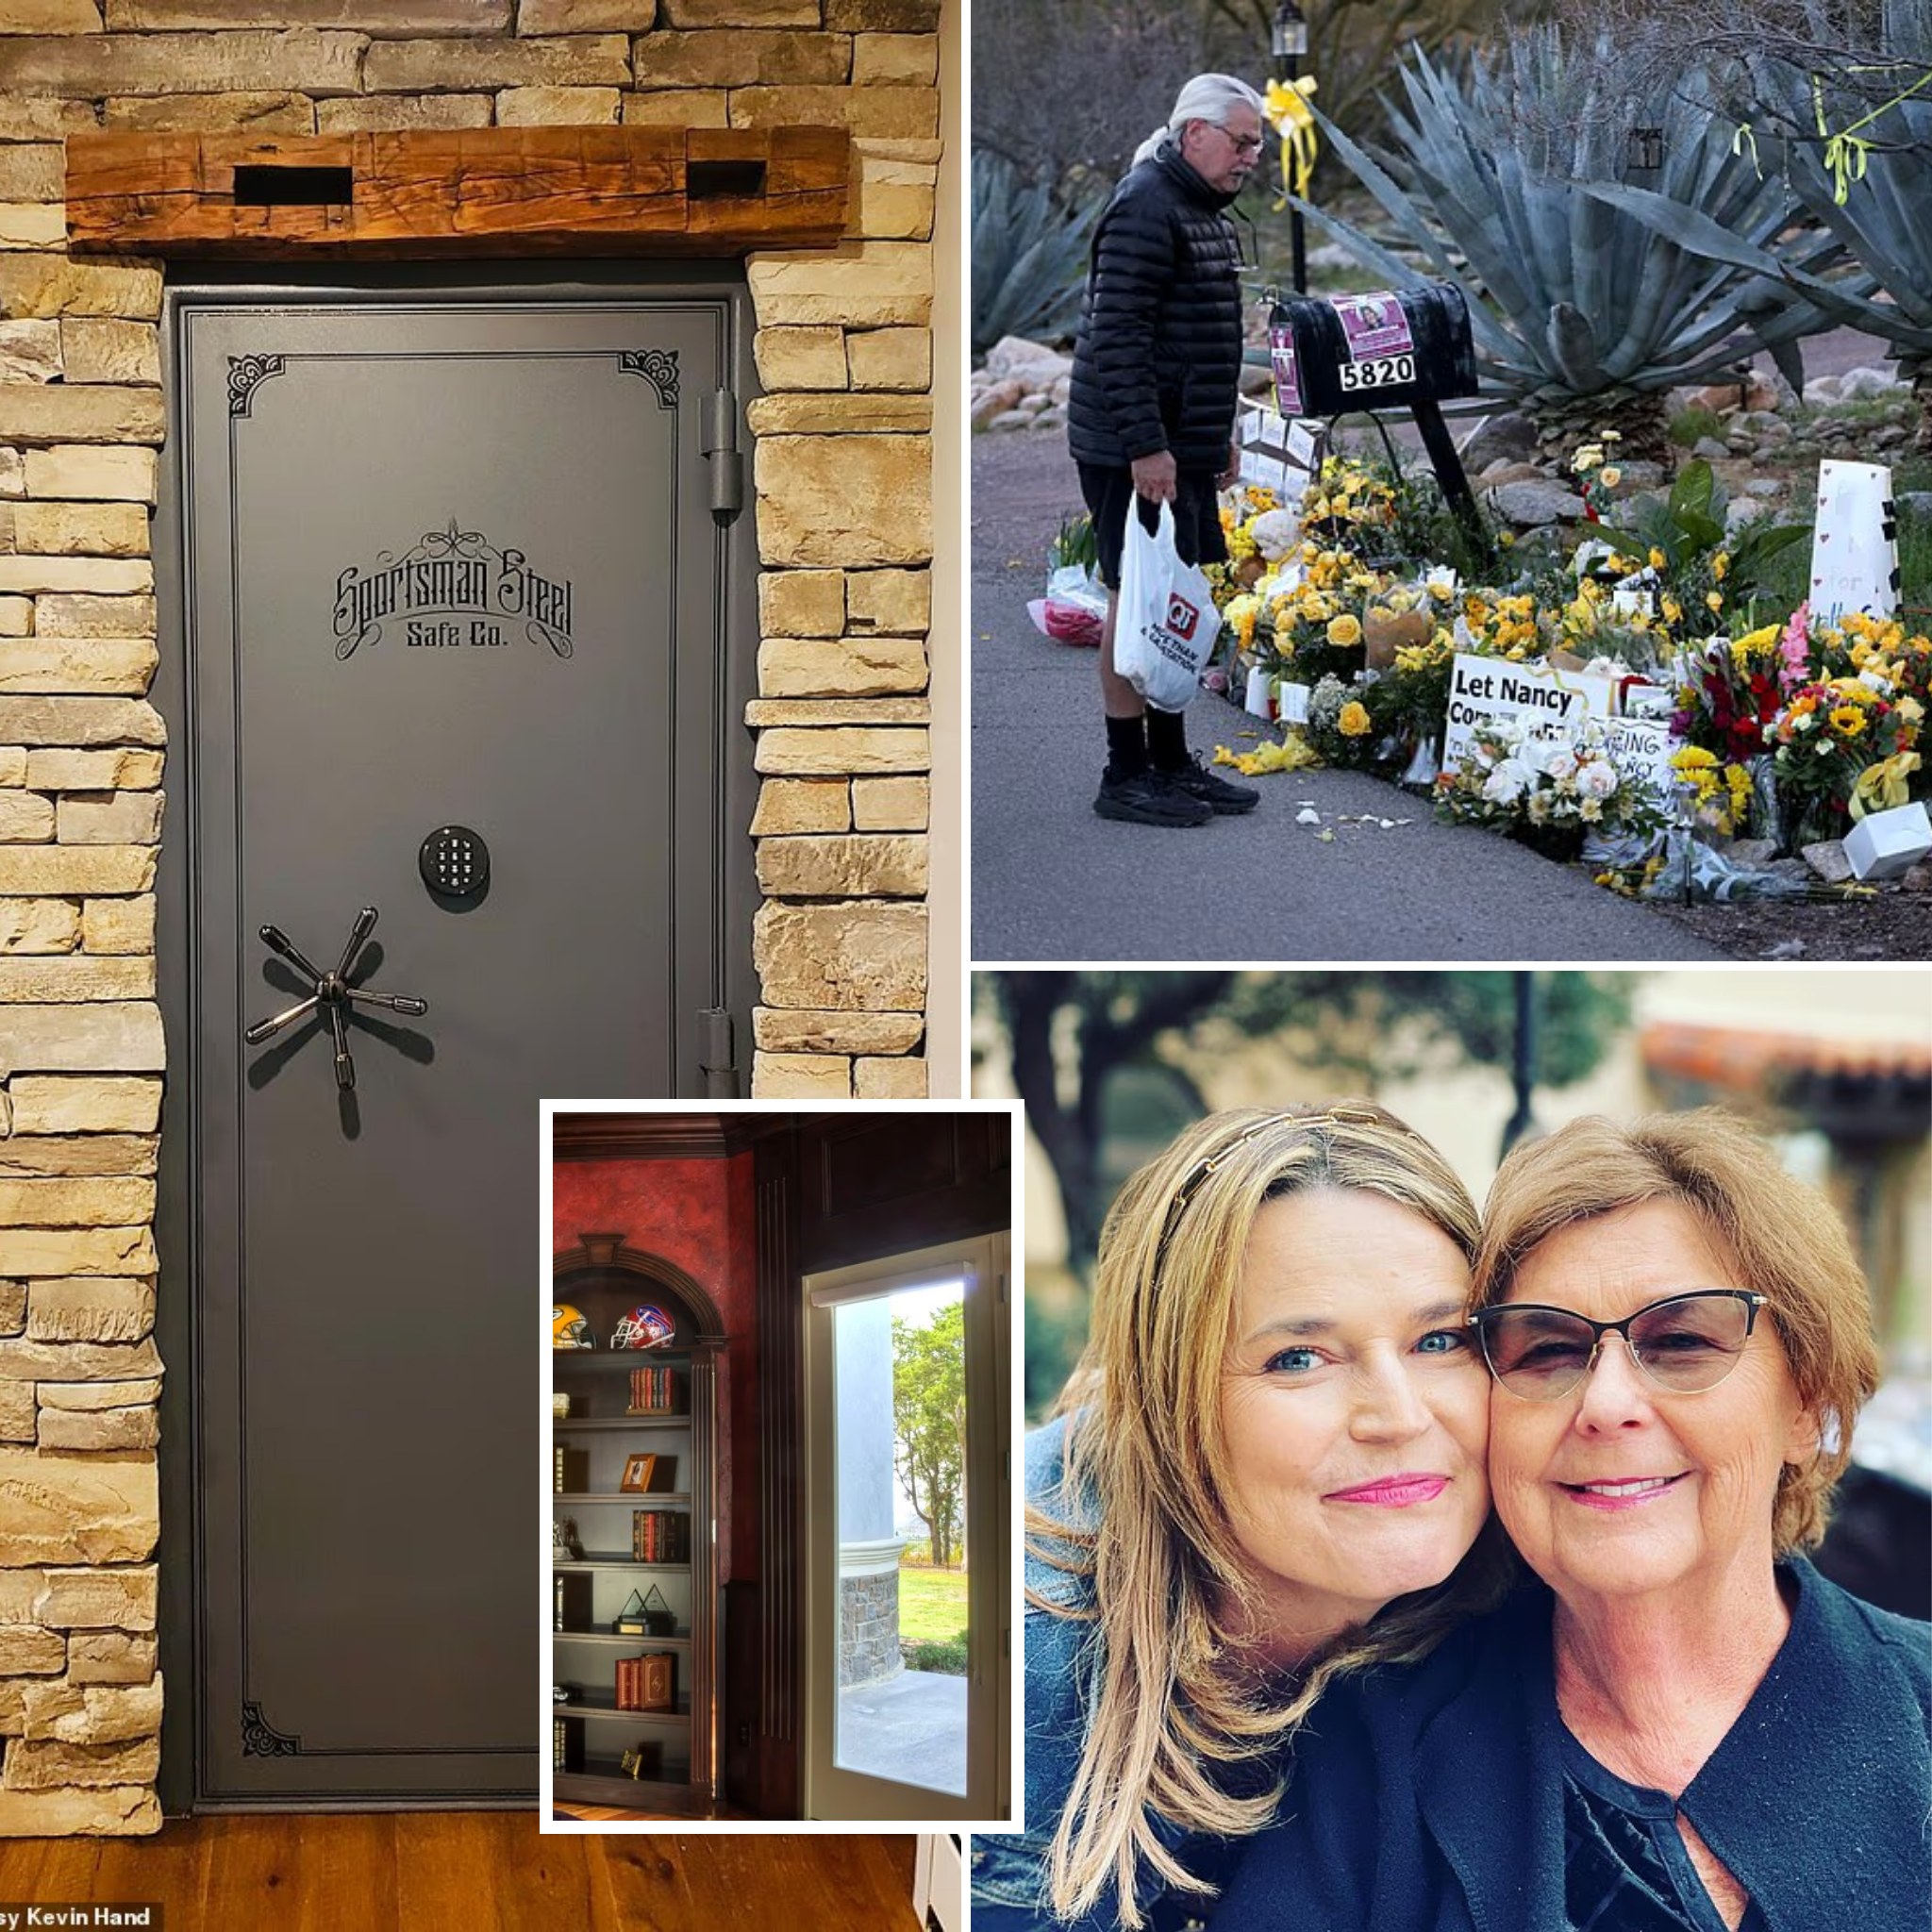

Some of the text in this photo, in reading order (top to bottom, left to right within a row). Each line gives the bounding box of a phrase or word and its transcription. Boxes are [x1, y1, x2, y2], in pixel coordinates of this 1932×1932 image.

[1343, 357, 1413, 388] 5820
[333, 549, 573, 641] Sportsman Steel
[407, 621, 508, 648] Safe Co.
[1456, 670, 1573, 718] Let Nancy
